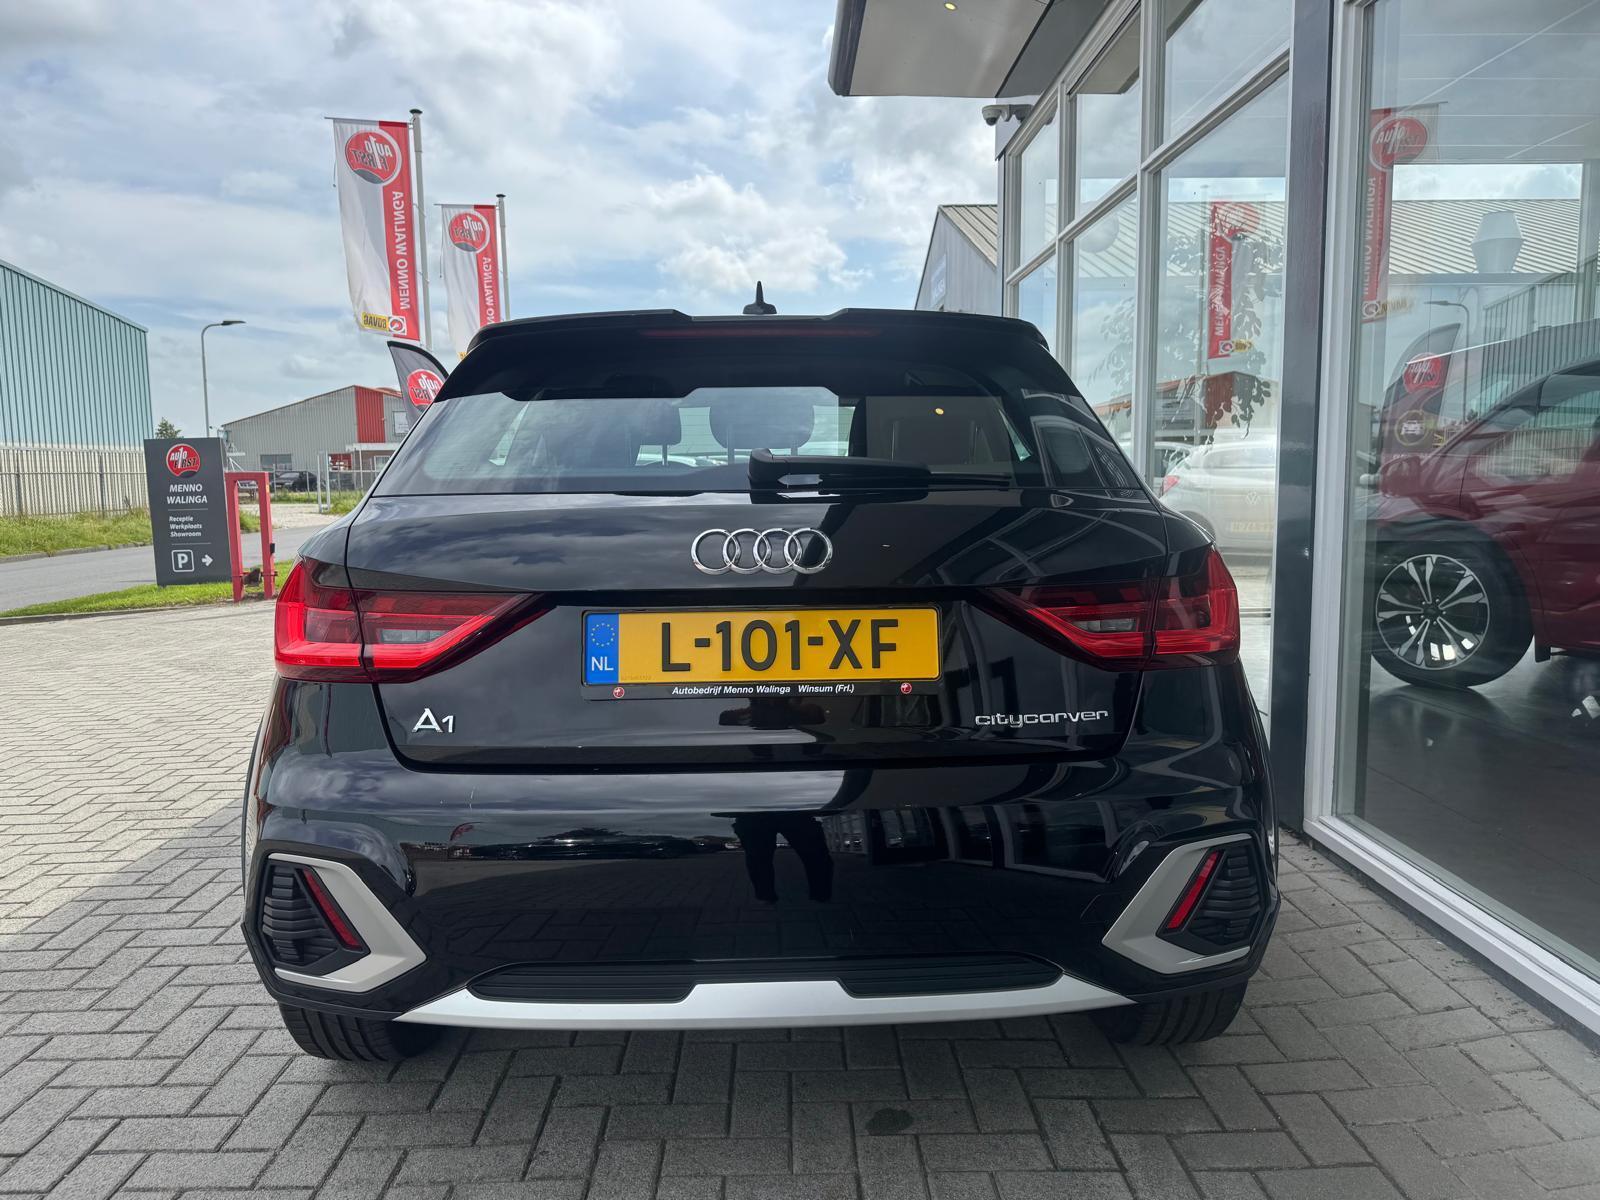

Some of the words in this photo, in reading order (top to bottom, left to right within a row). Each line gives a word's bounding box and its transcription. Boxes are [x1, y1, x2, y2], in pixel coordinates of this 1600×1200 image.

[169, 484, 203, 492] MENNO
[166, 495, 208, 504] WALINGA
[661, 619, 898, 672] L-101-XF
[591, 656, 614, 671] NL
[672, 686, 722, 697] Autobedrijf
[724, 686, 754, 694] Menno
[756, 685, 790, 695] Walinga
[798, 684, 833, 693] Winsum
[412, 708, 454, 733] A1
[975, 711, 1108, 728] citycarver
